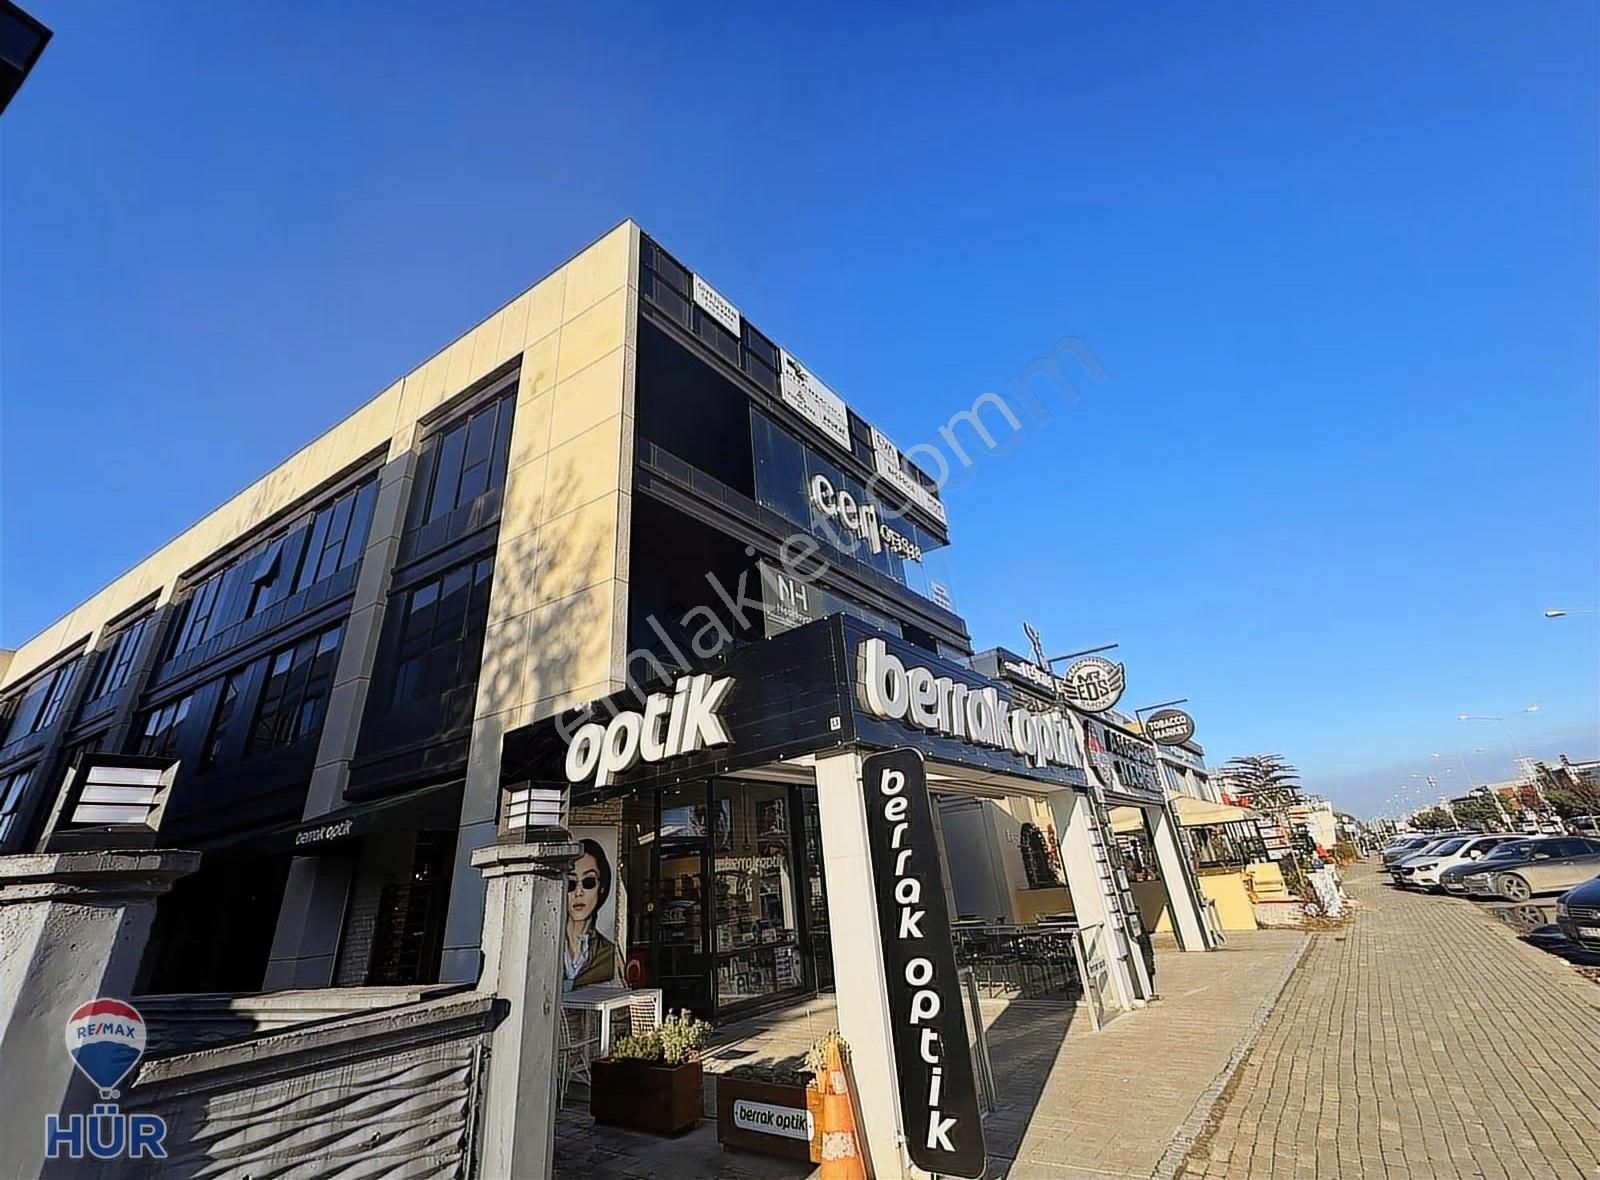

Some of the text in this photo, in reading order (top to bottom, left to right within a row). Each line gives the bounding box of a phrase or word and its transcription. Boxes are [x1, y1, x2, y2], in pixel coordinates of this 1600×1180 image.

[857, 637, 1012, 750] berrak
[1147, 715, 1187, 731] TOBACCO
[565, 673, 736, 788] optik
[1153, 725, 1188, 740] MARKET
[880, 768, 958, 1153] berrak optik
[739, 1105, 807, 1131] berrak optik
